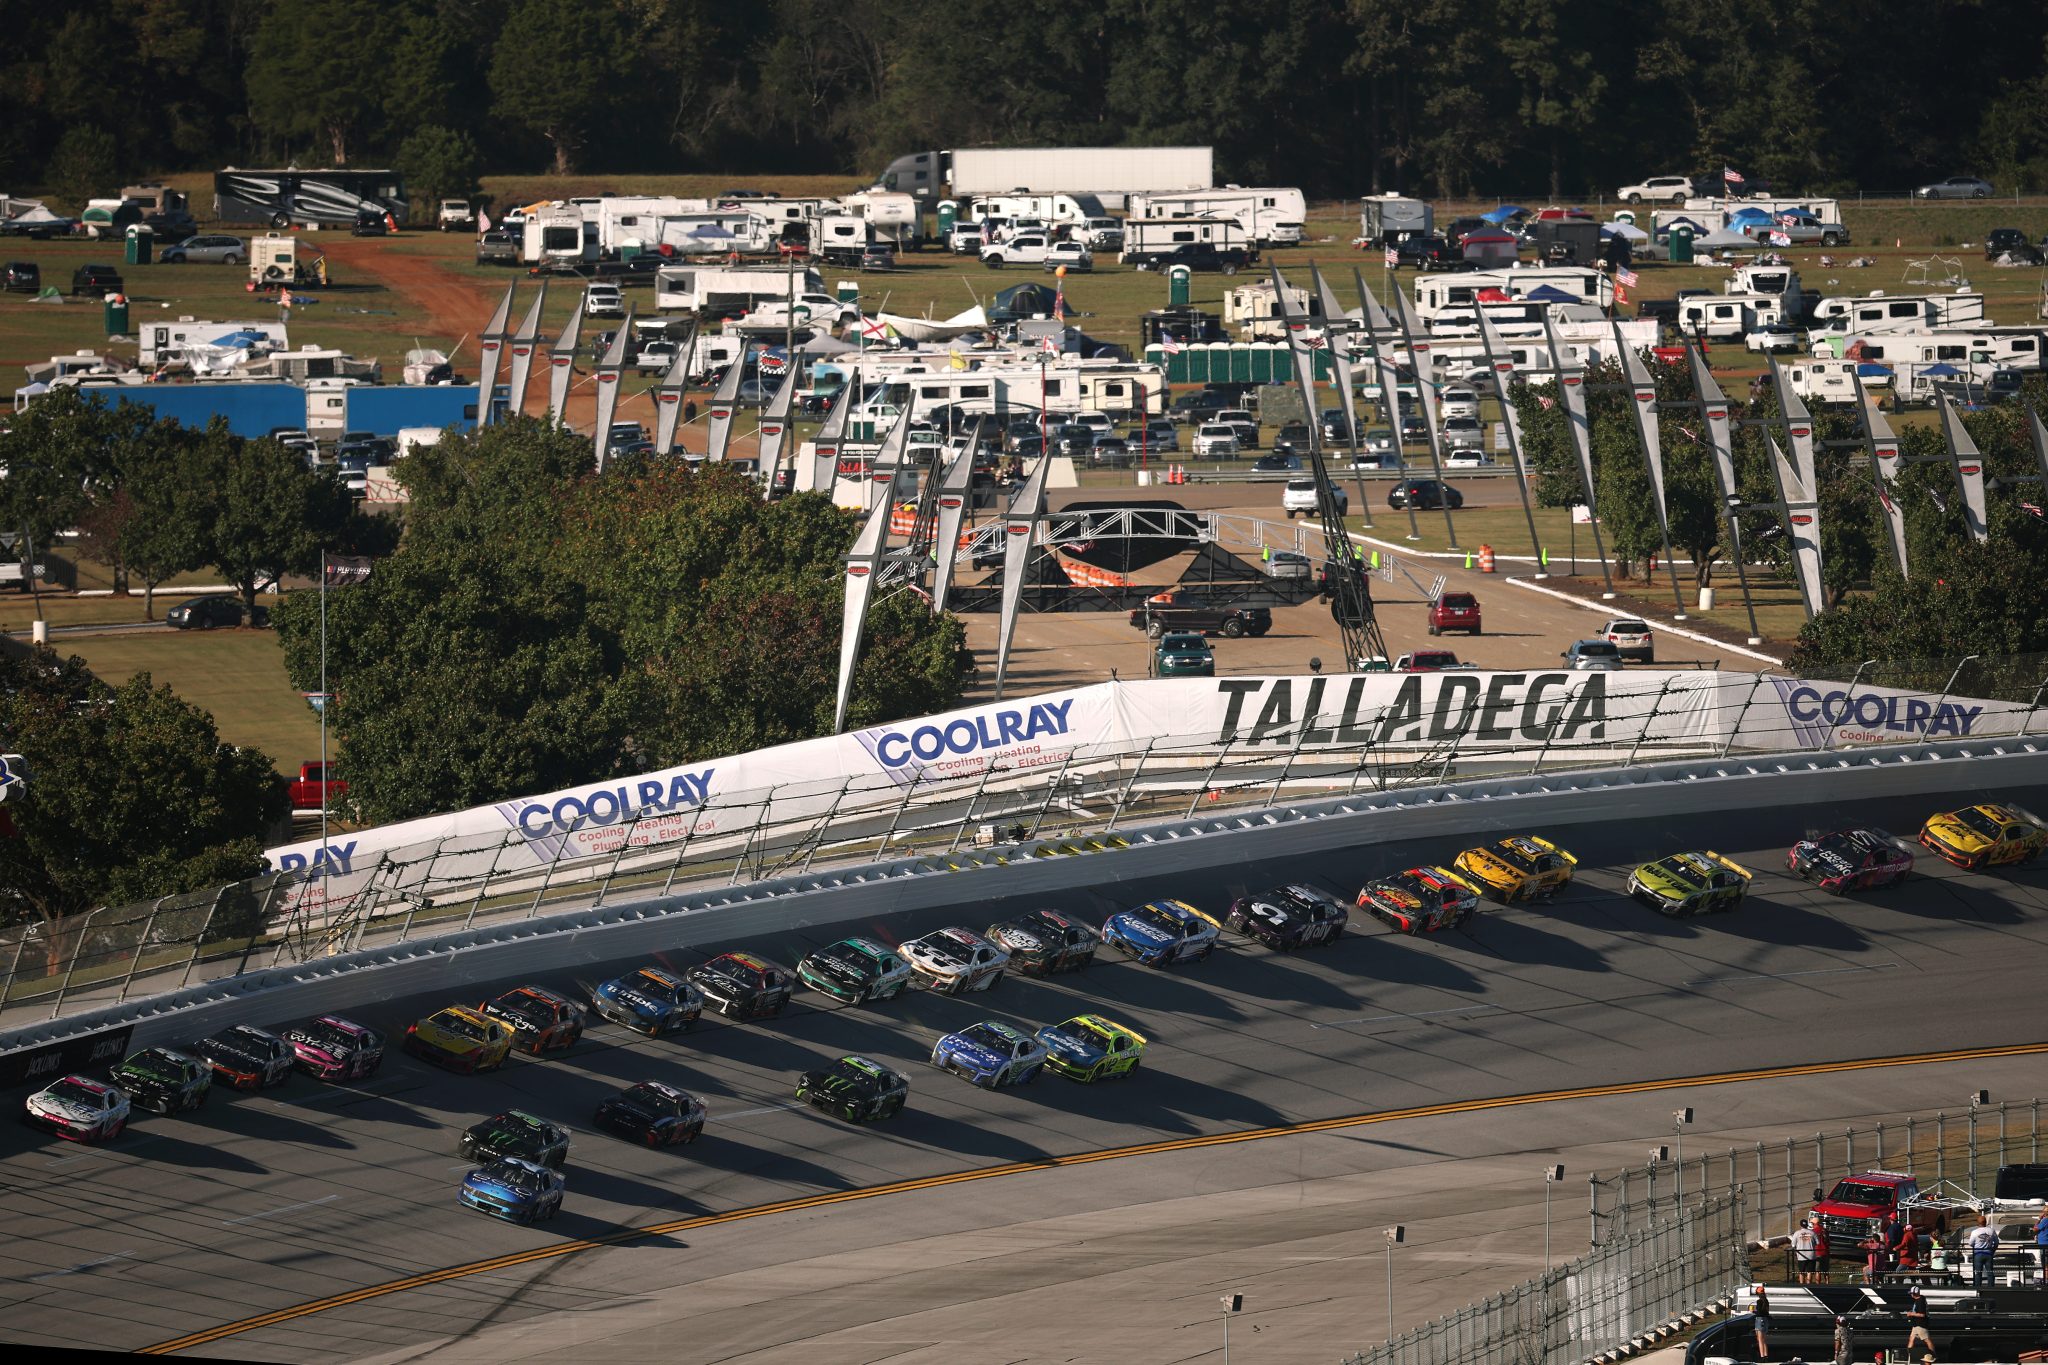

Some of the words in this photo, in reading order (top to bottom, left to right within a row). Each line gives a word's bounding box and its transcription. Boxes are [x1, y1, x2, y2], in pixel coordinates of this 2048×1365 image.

[337, 566, 371, 575] PLAYOFFS
[1217, 673, 1606, 747] TALLADEGA
[1789, 686, 1984, 737] COOLRAY
[877, 698, 1074, 768] COOLRAY
[937, 756, 984, 772] Cooling
[518, 768, 716, 839] COOLRAY
[578, 827, 625, 843] Cooling
[635, 814, 683, 832] Heating
[997, 926, 1044, 951] BUSCH
[501, 1012, 541, 1034] Kroger
